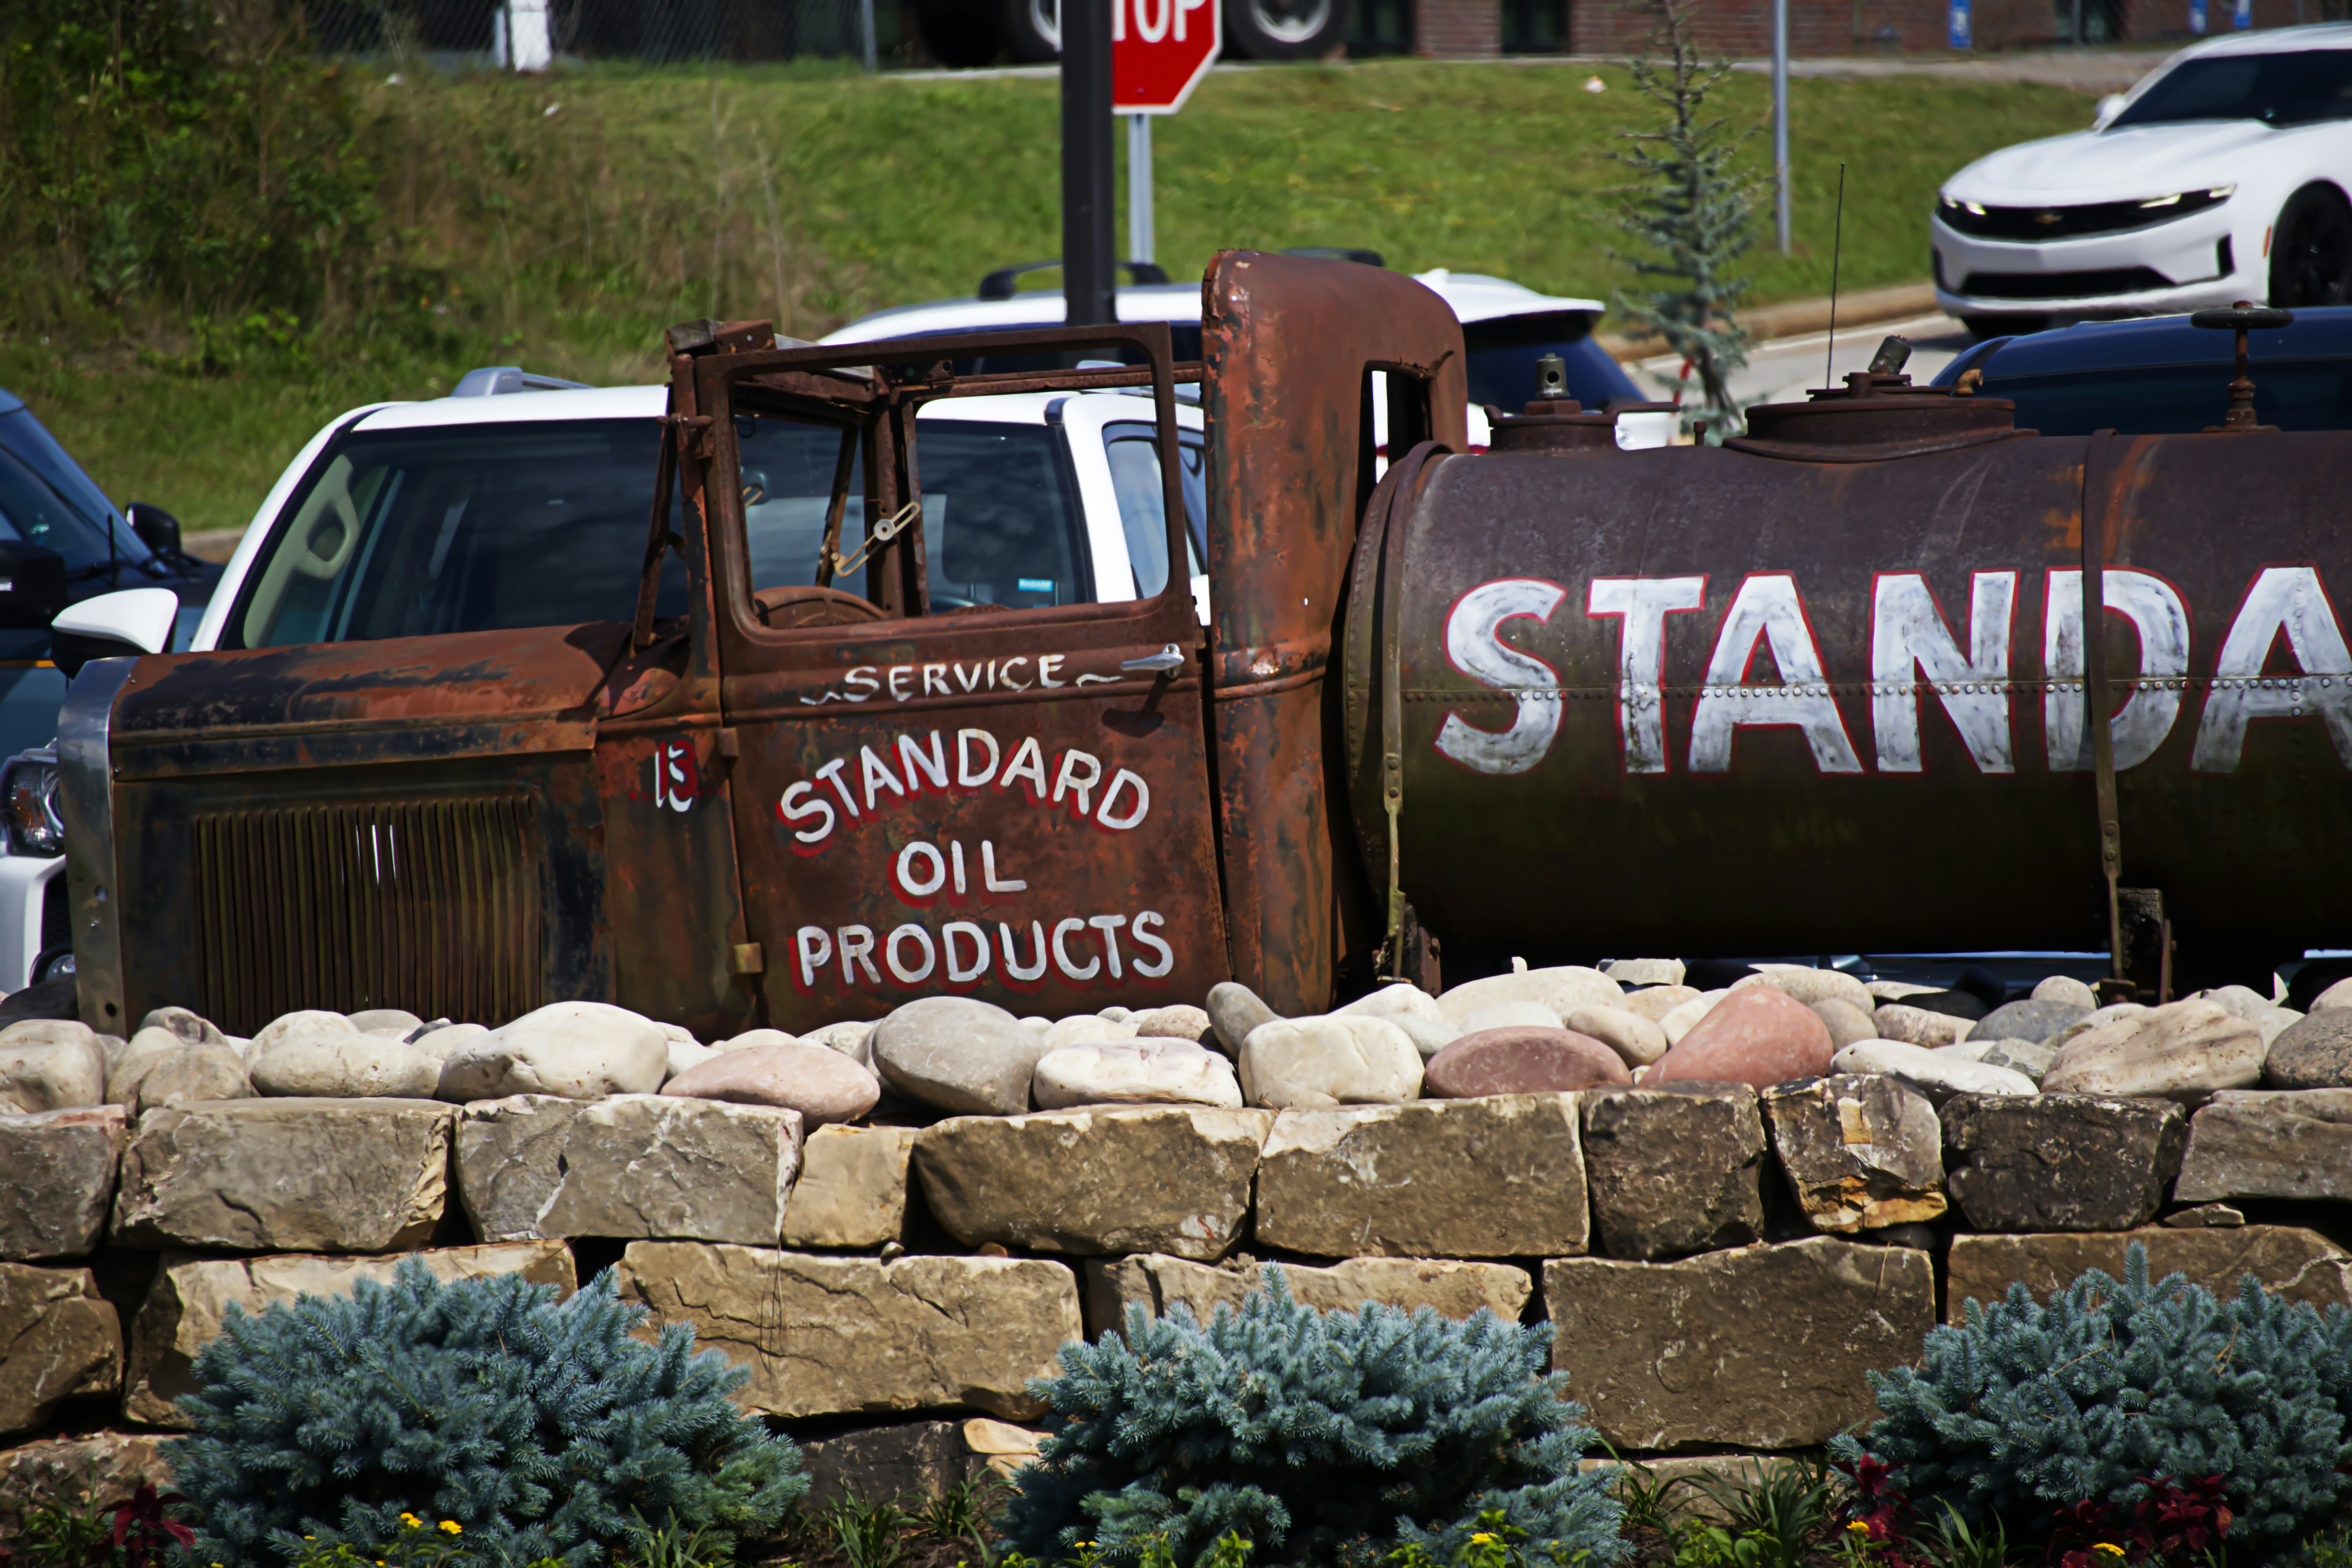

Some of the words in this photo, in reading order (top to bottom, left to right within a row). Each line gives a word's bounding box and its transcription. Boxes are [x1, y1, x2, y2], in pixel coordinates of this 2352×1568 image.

[843, 654, 1067, 702] SERVICE
[780, 728, 1149, 844] STANDARD
[896, 840, 1028, 897] OIL
[796, 910, 1174, 987] PRODUCTS
